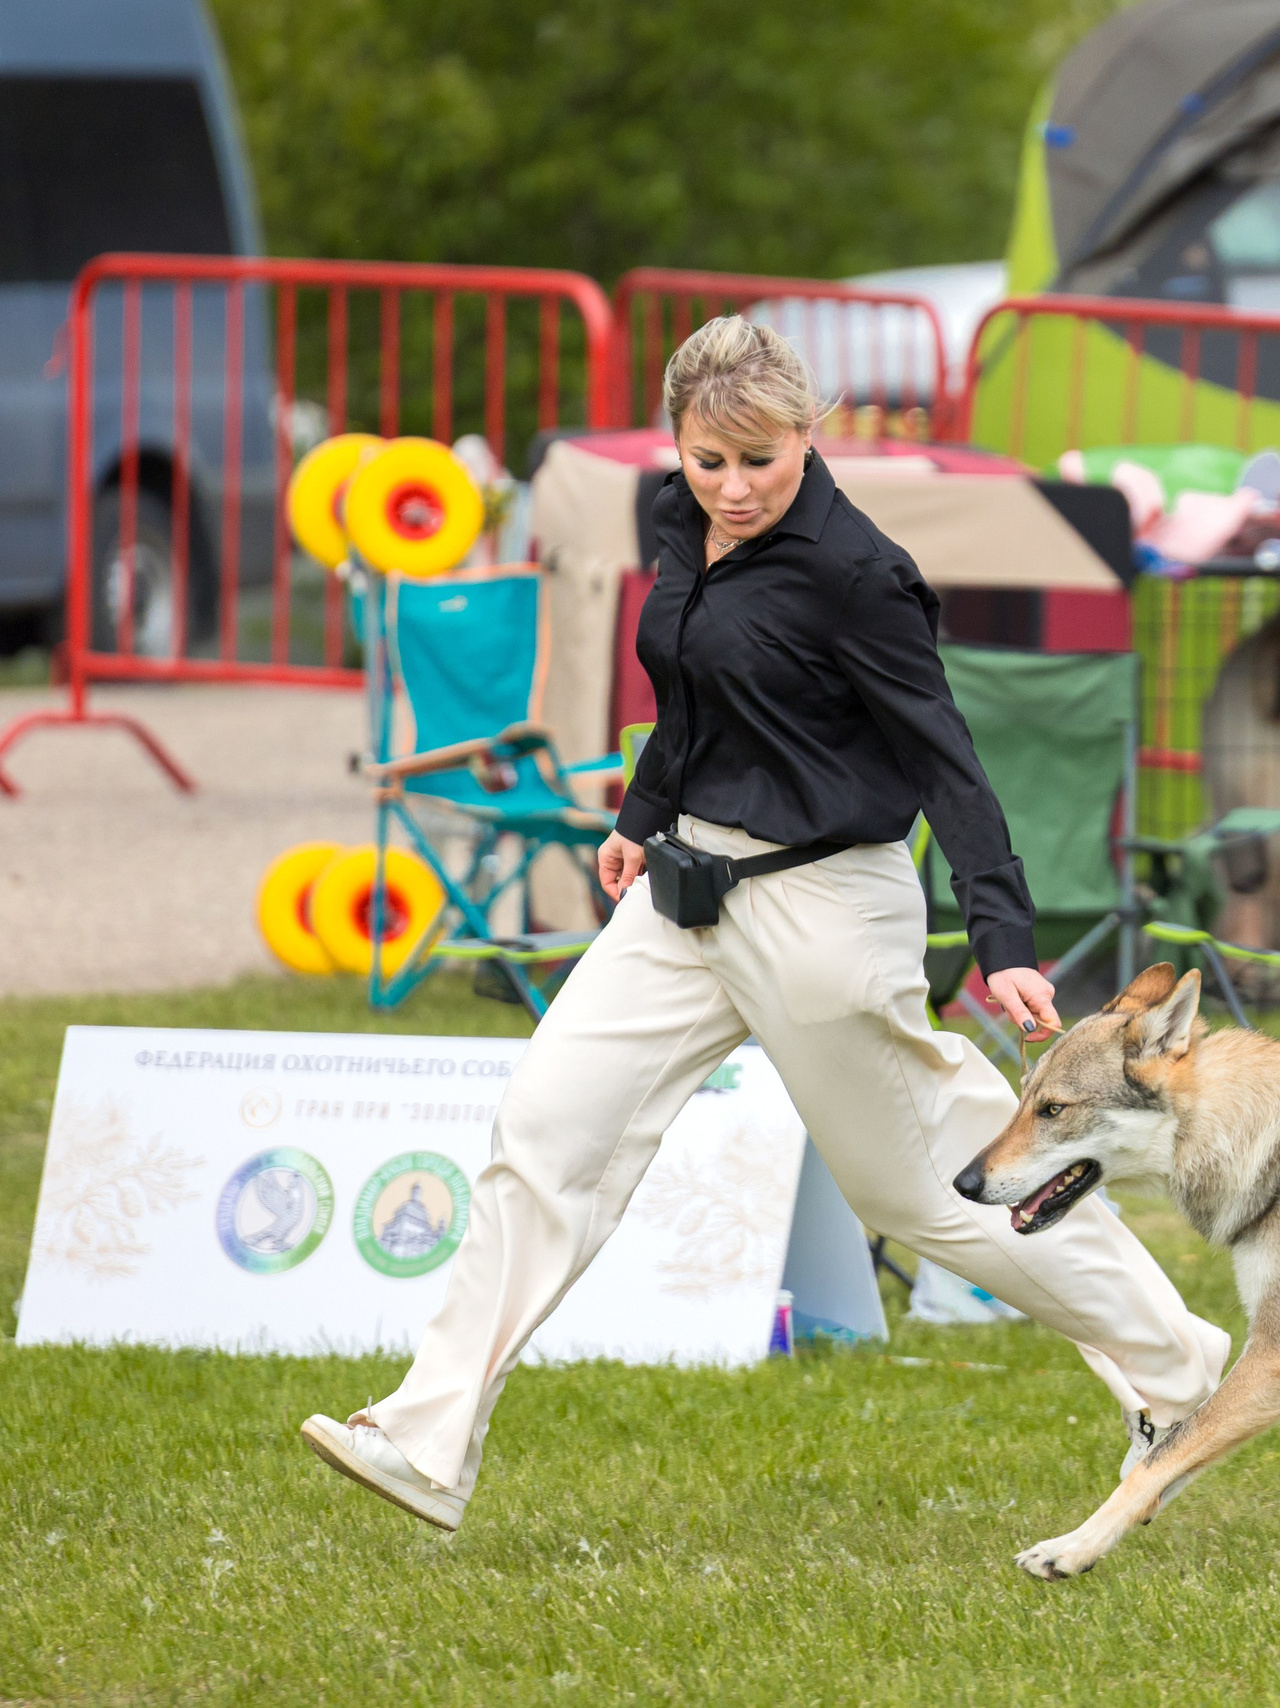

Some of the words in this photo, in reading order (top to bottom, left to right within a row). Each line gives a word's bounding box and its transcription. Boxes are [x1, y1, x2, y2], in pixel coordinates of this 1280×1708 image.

[134, 1049, 277, 1073] ФЕДЕРАЦИЯ
[281, 1053, 457, 1076] ОХОТНИЧЬЕГО
[460, 1059, 514, 1077] СОБ
[295, 1099, 345, 1119] ГРАН
[352, 1100, 391, 1120] ПРИ
